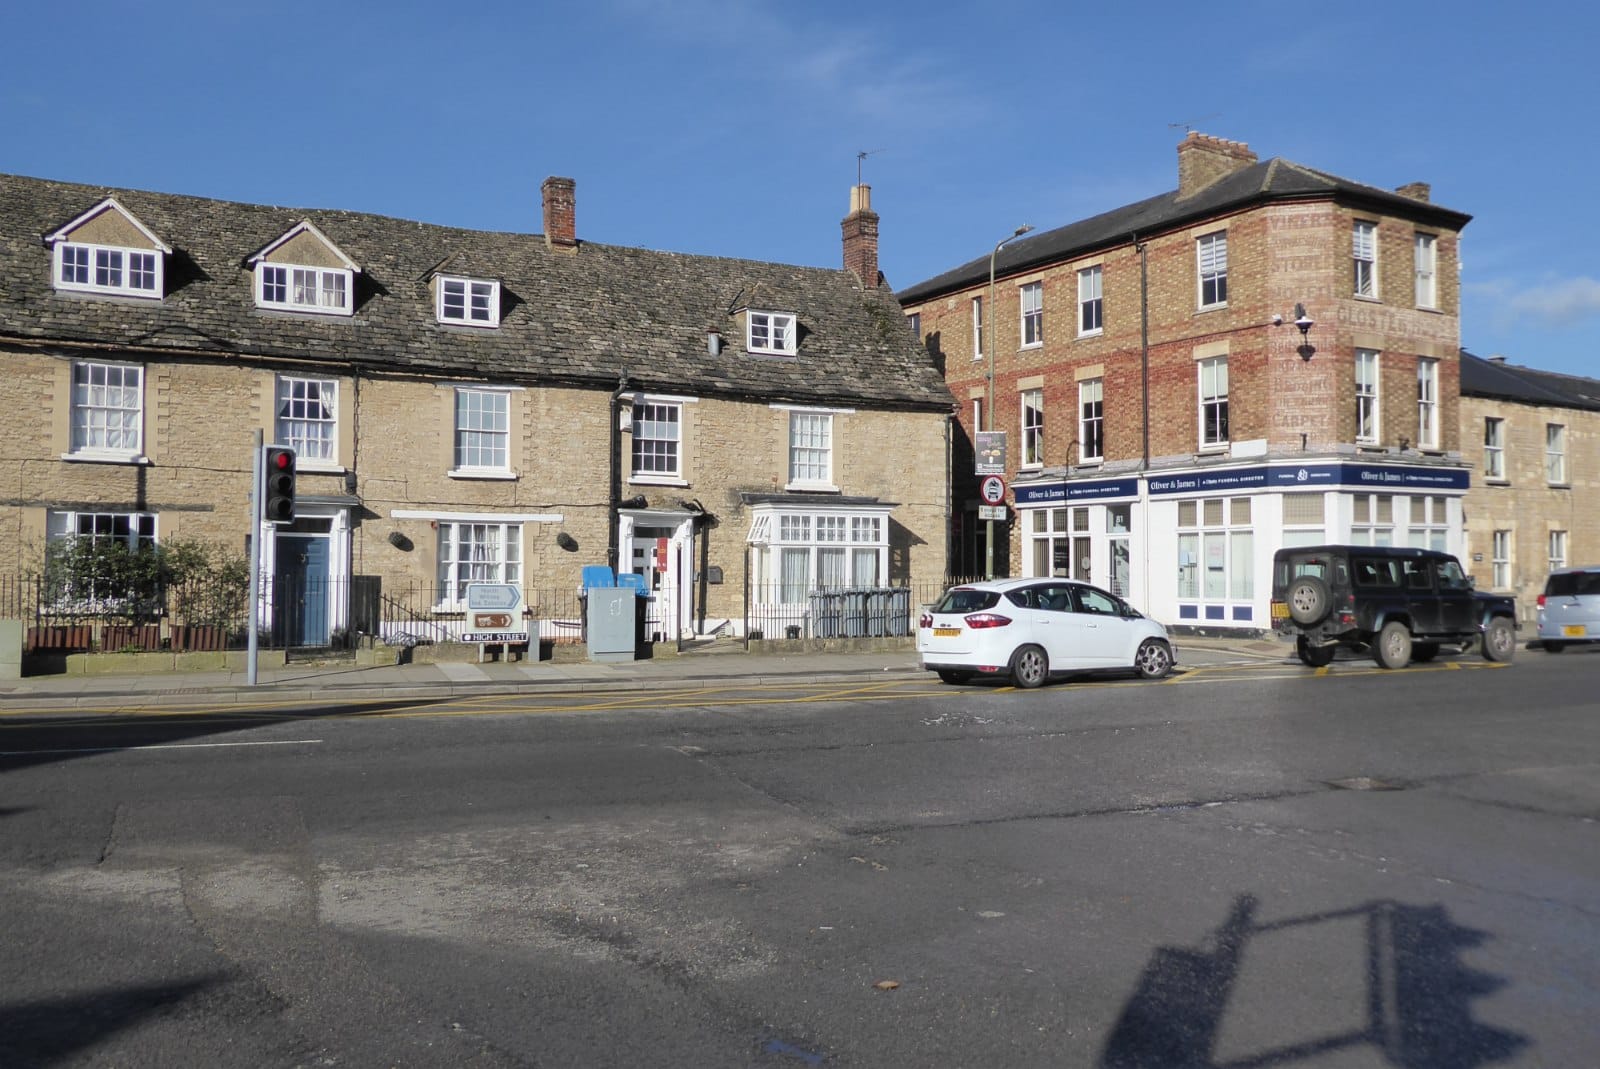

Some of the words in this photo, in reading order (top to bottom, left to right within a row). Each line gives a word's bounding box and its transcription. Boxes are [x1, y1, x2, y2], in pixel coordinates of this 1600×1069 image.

[1150, 481, 1169, 490] Oliver
[1170, 480, 1176, 488] &
[1176, 479, 1196, 489] James
[1028, 490, 1044, 499] Oliver
[1049, 489, 1065, 498] James
[496, 633, 525, 641] STREET
